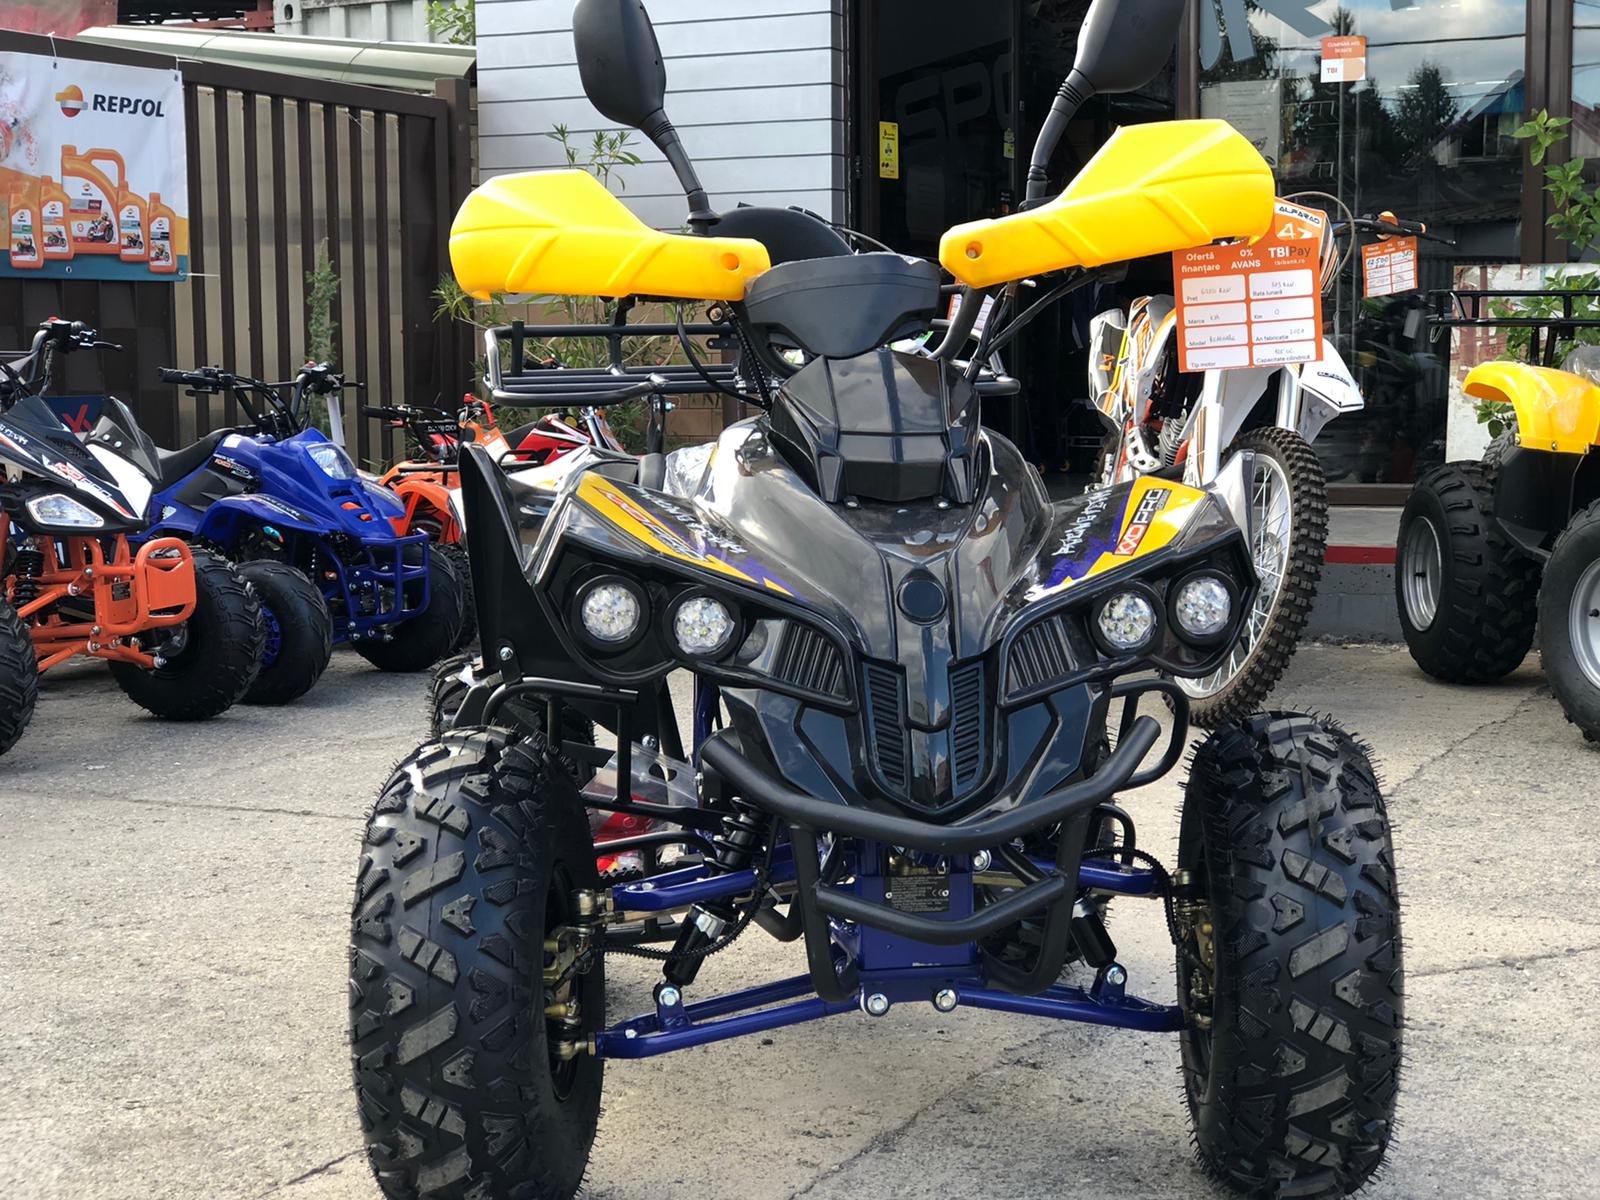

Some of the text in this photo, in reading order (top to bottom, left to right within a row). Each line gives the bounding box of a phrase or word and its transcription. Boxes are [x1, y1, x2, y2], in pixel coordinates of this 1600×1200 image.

[92, 93, 165, 118] REPSOL
[1186, 251, 1215, 262] Ofertă
[1239, 248, 1254, 257] 0%
[1267, 246, 1312, 259] TBIPay
[1231, 259, 1261, 270] AVANS
[1273, 258, 1306, 266] tbibank.ro
[1115, 525, 1145, 555] KXD
[1133, 488, 1164, 524] PRO
